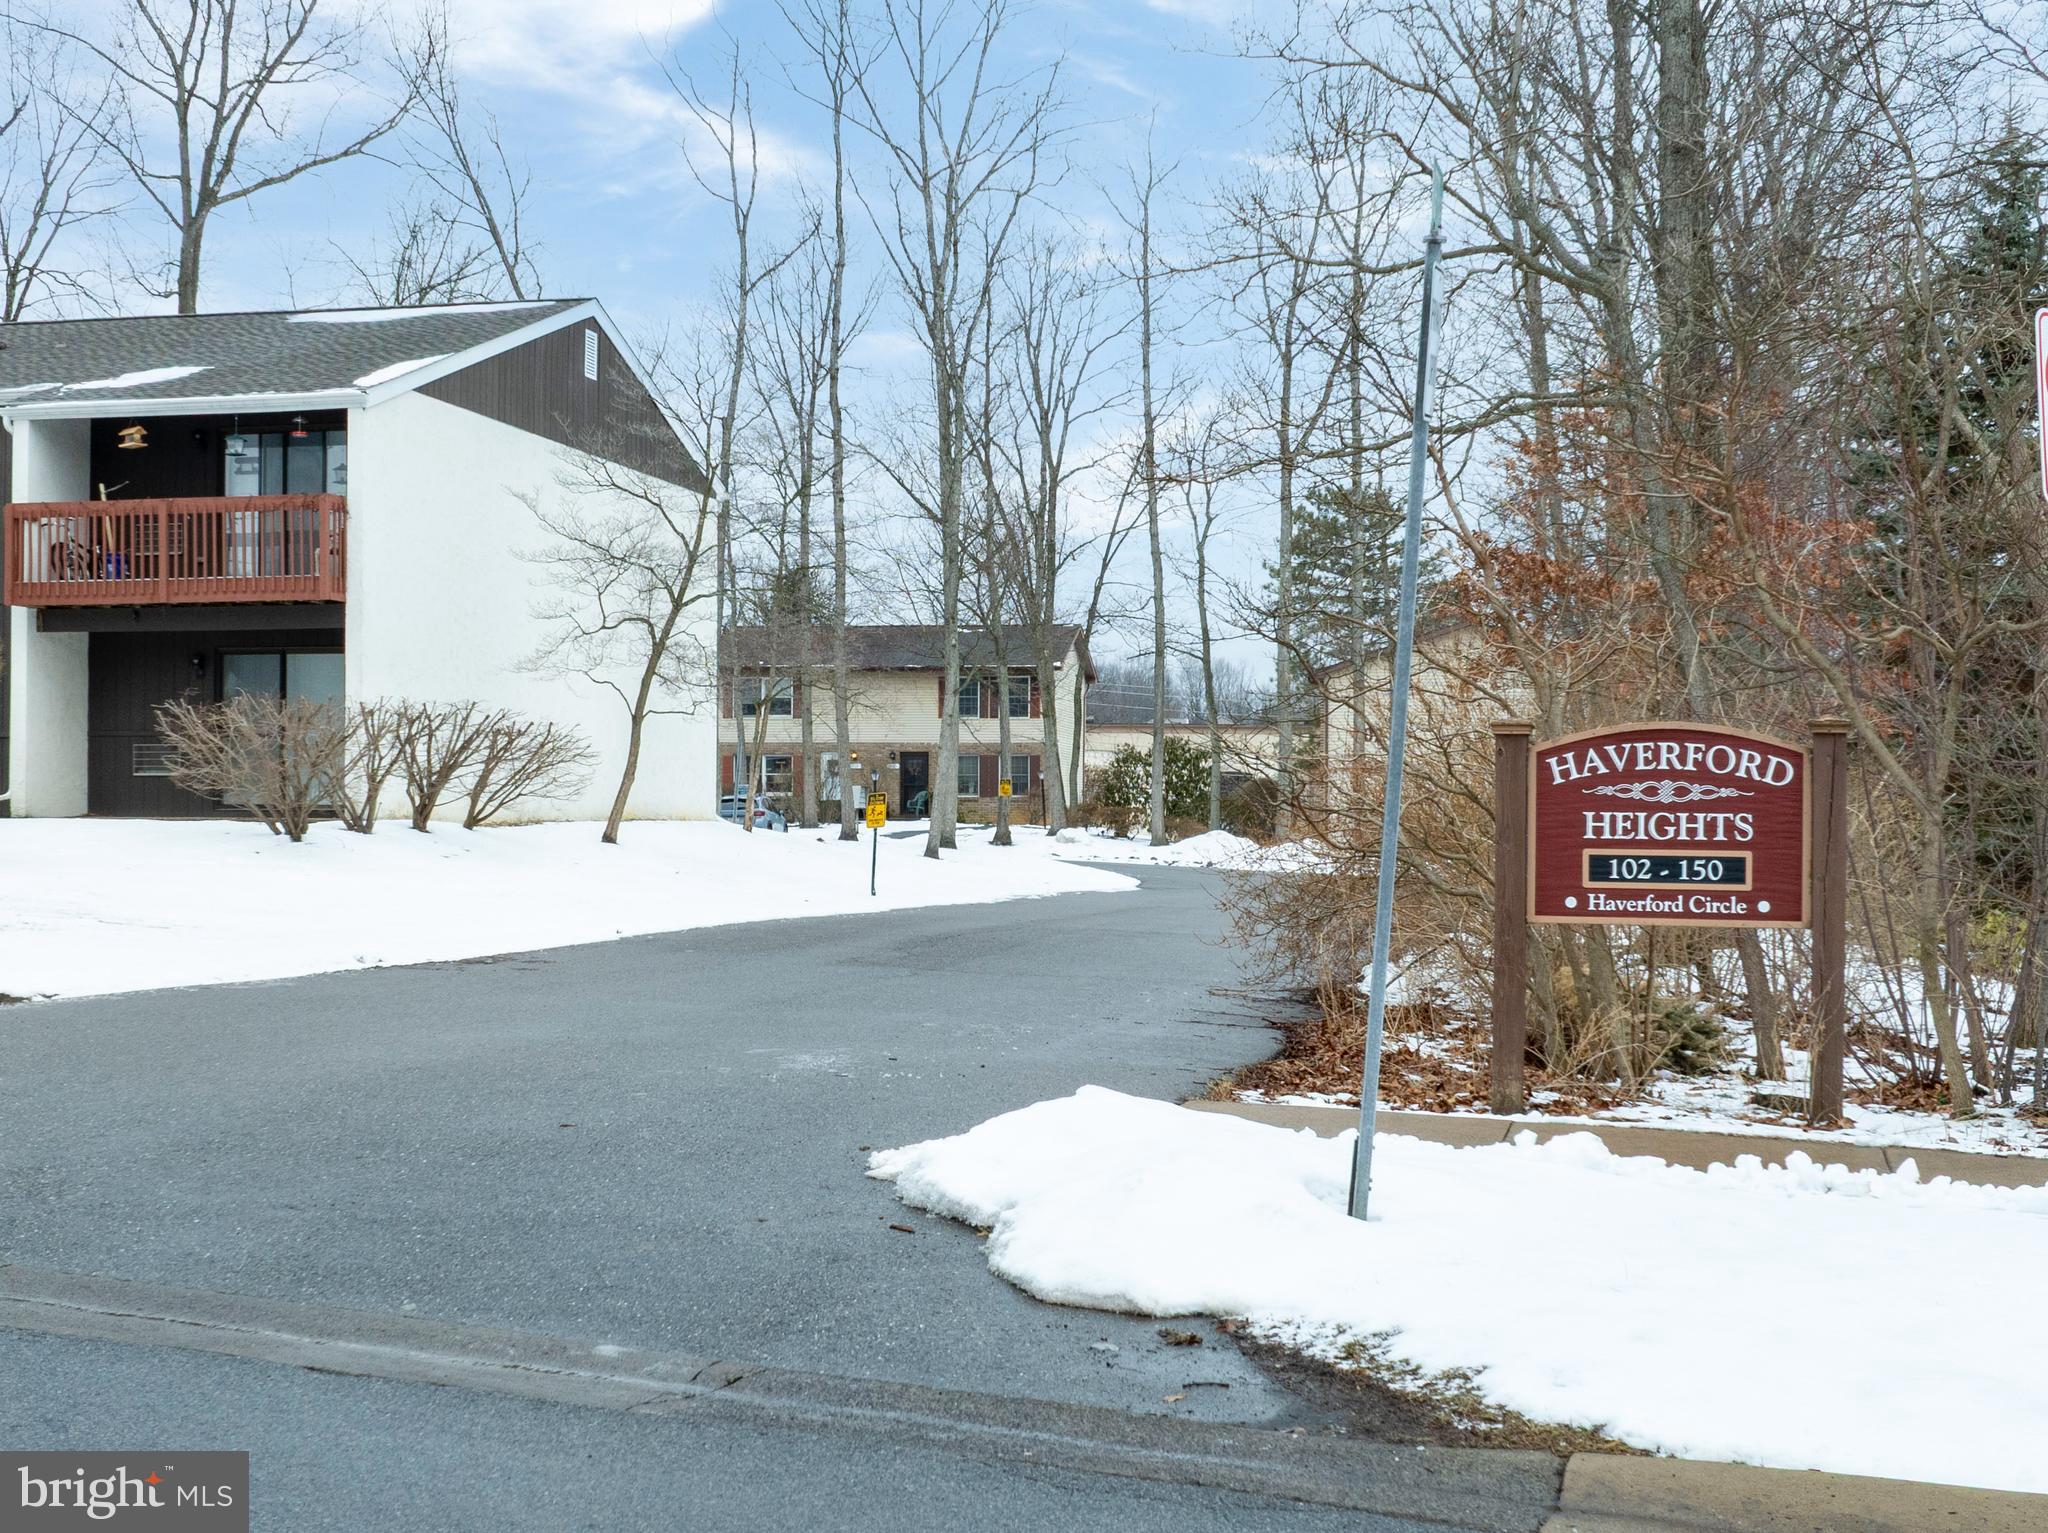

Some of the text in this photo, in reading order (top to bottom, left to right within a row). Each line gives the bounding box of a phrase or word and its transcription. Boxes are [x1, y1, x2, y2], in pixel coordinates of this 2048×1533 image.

[1545, 741, 1795, 787] HAVERFORD
[1582, 811, 1754, 841] HEIGHTS
[1608, 858, 1652, 880] 102
[1678, 859, 1723, 881] 150
[1587, 893, 1748, 914] Haverford Circle
